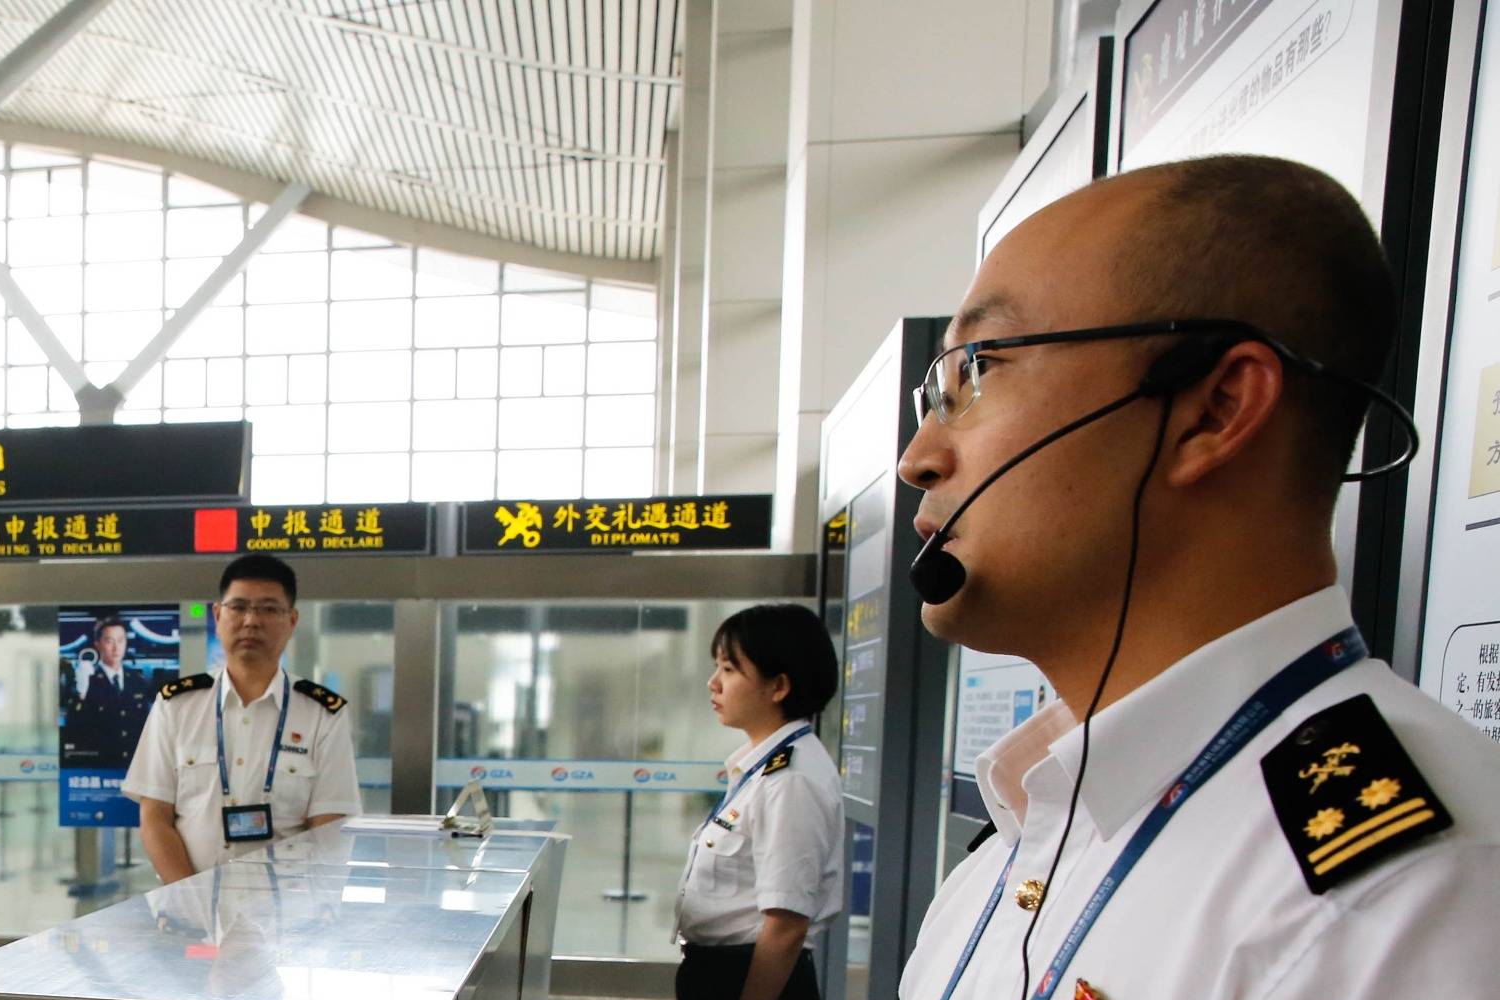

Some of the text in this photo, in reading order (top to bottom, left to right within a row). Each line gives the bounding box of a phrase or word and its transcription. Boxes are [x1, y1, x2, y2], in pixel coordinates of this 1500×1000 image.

[250, 507, 384, 537] 申报通道
[553, 500, 731, 532] 外交礼遇通道
[246, 535, 384, 550] GOODS TO DECLARE
[591, 532, 680, 546] DIPLOMATS
[39, 543, 56, 555] TO
[62, 541, 123, 555] DECLARE
[490, 769, 514, 779] GZA
[570, 770, 595, 780] GZA
[652, 771, 677, 782] GZA
